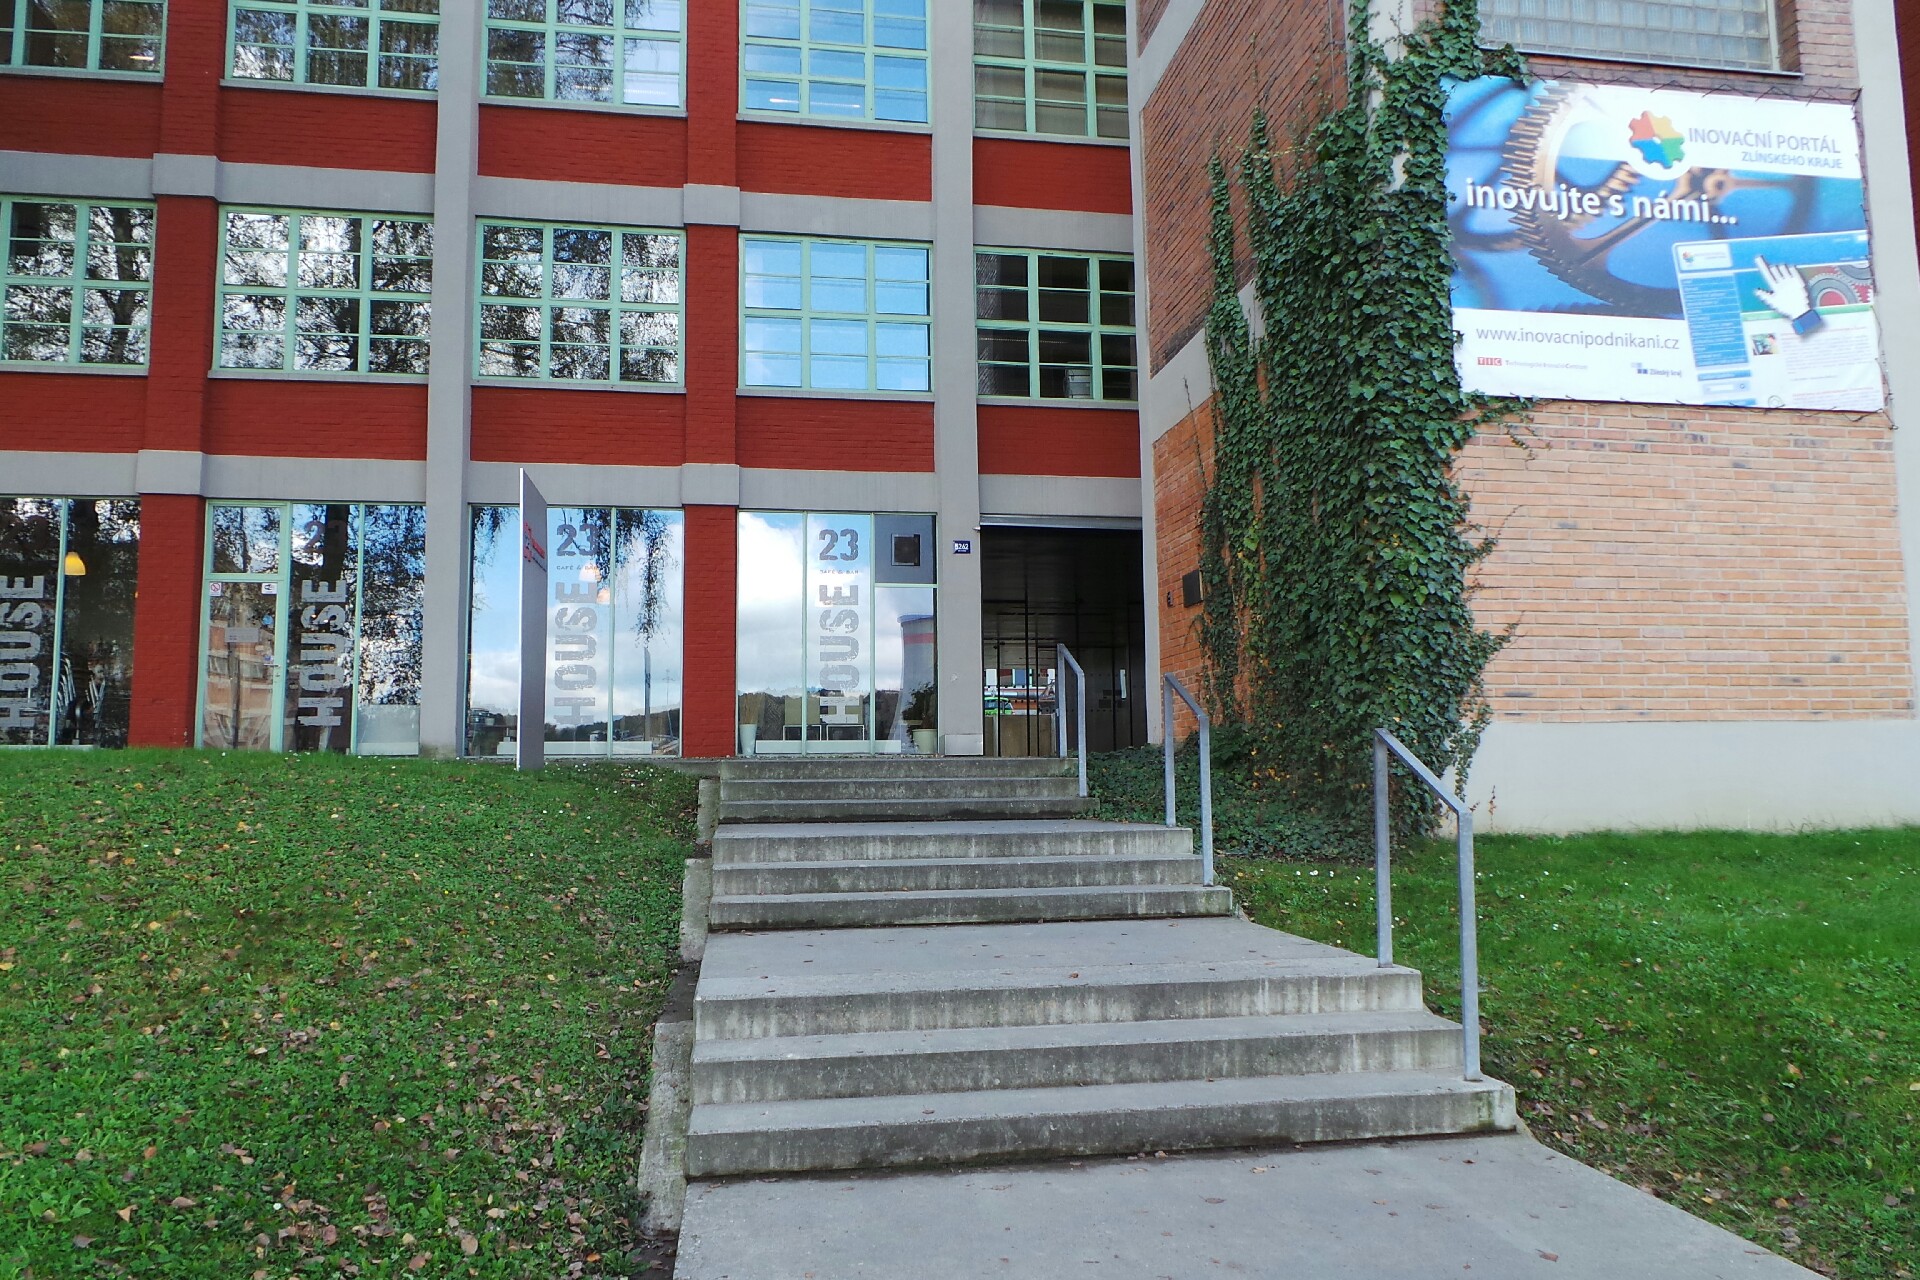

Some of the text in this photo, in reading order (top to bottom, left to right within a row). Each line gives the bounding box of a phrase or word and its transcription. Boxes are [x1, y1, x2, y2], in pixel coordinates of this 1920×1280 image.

[1689, 128, 1841, 154] INOVAČNÍ PORTÁL
[1741, 150, 1843, 169] ZLÍNSKÉHO KRAJE
[1466, 177, 1738, 225] inovujte s námi...
[1476, 328, 1680, 350] www.inovacnipodnikani.cz
[1478, 357, 1502, 366] TIC
[556, 524, 599, 557] 23
[818, 528, 859, 561] 23
[0, 575, 44, 728] HOUSE
[297, 579, 347, 727] HOUSE
[554, 582, 598, 726] HOUSE
[819, 584, 860, 724] HOUSE
